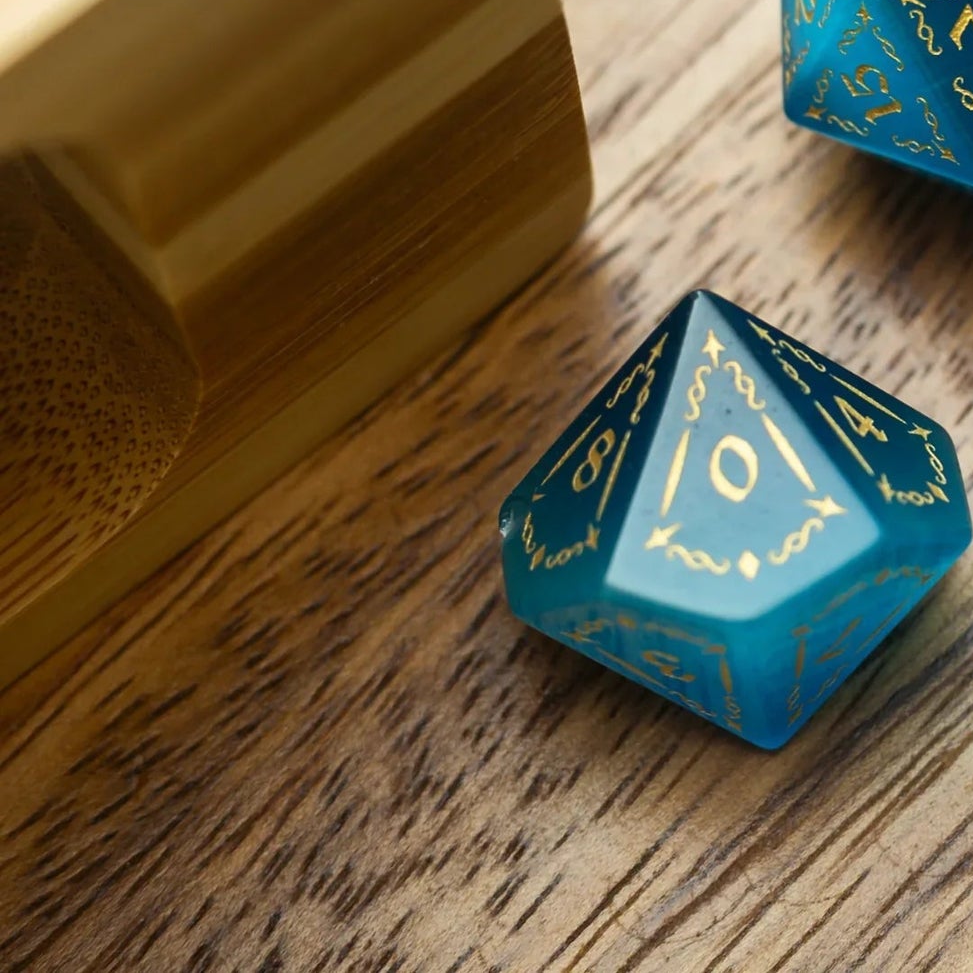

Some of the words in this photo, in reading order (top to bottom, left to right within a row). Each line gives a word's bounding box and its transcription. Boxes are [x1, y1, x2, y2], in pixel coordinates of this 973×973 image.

[841, 64, 902, 125] 15
[833, 395, 889, 442] 4
[572, 429, 617, 493] 8
[710, 435, 758, 503] 0
